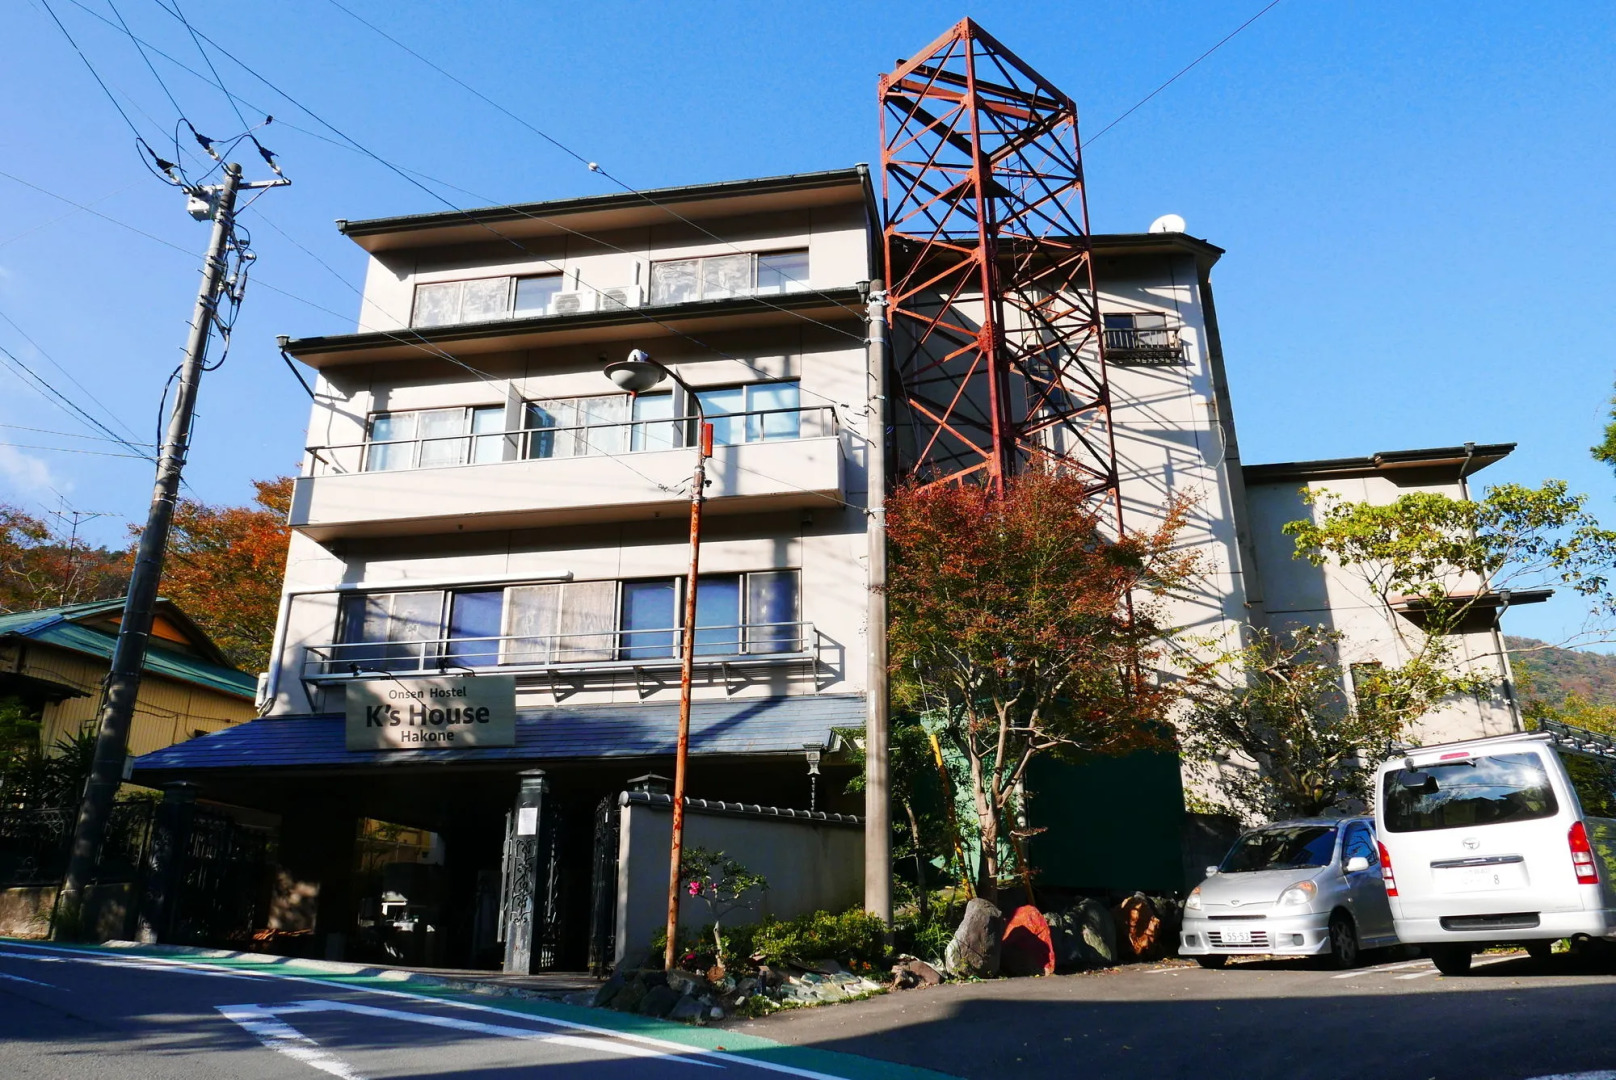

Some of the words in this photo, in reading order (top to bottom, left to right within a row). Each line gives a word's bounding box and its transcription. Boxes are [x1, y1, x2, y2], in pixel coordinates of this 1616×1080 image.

[388, 689, 424, 699] Onsen
[430, 686, 467, 698] Hostel
[366, 704, 401, 728] K's
[409, 704, 490, 726] House
[401, 729, 455, 743] Hakone
